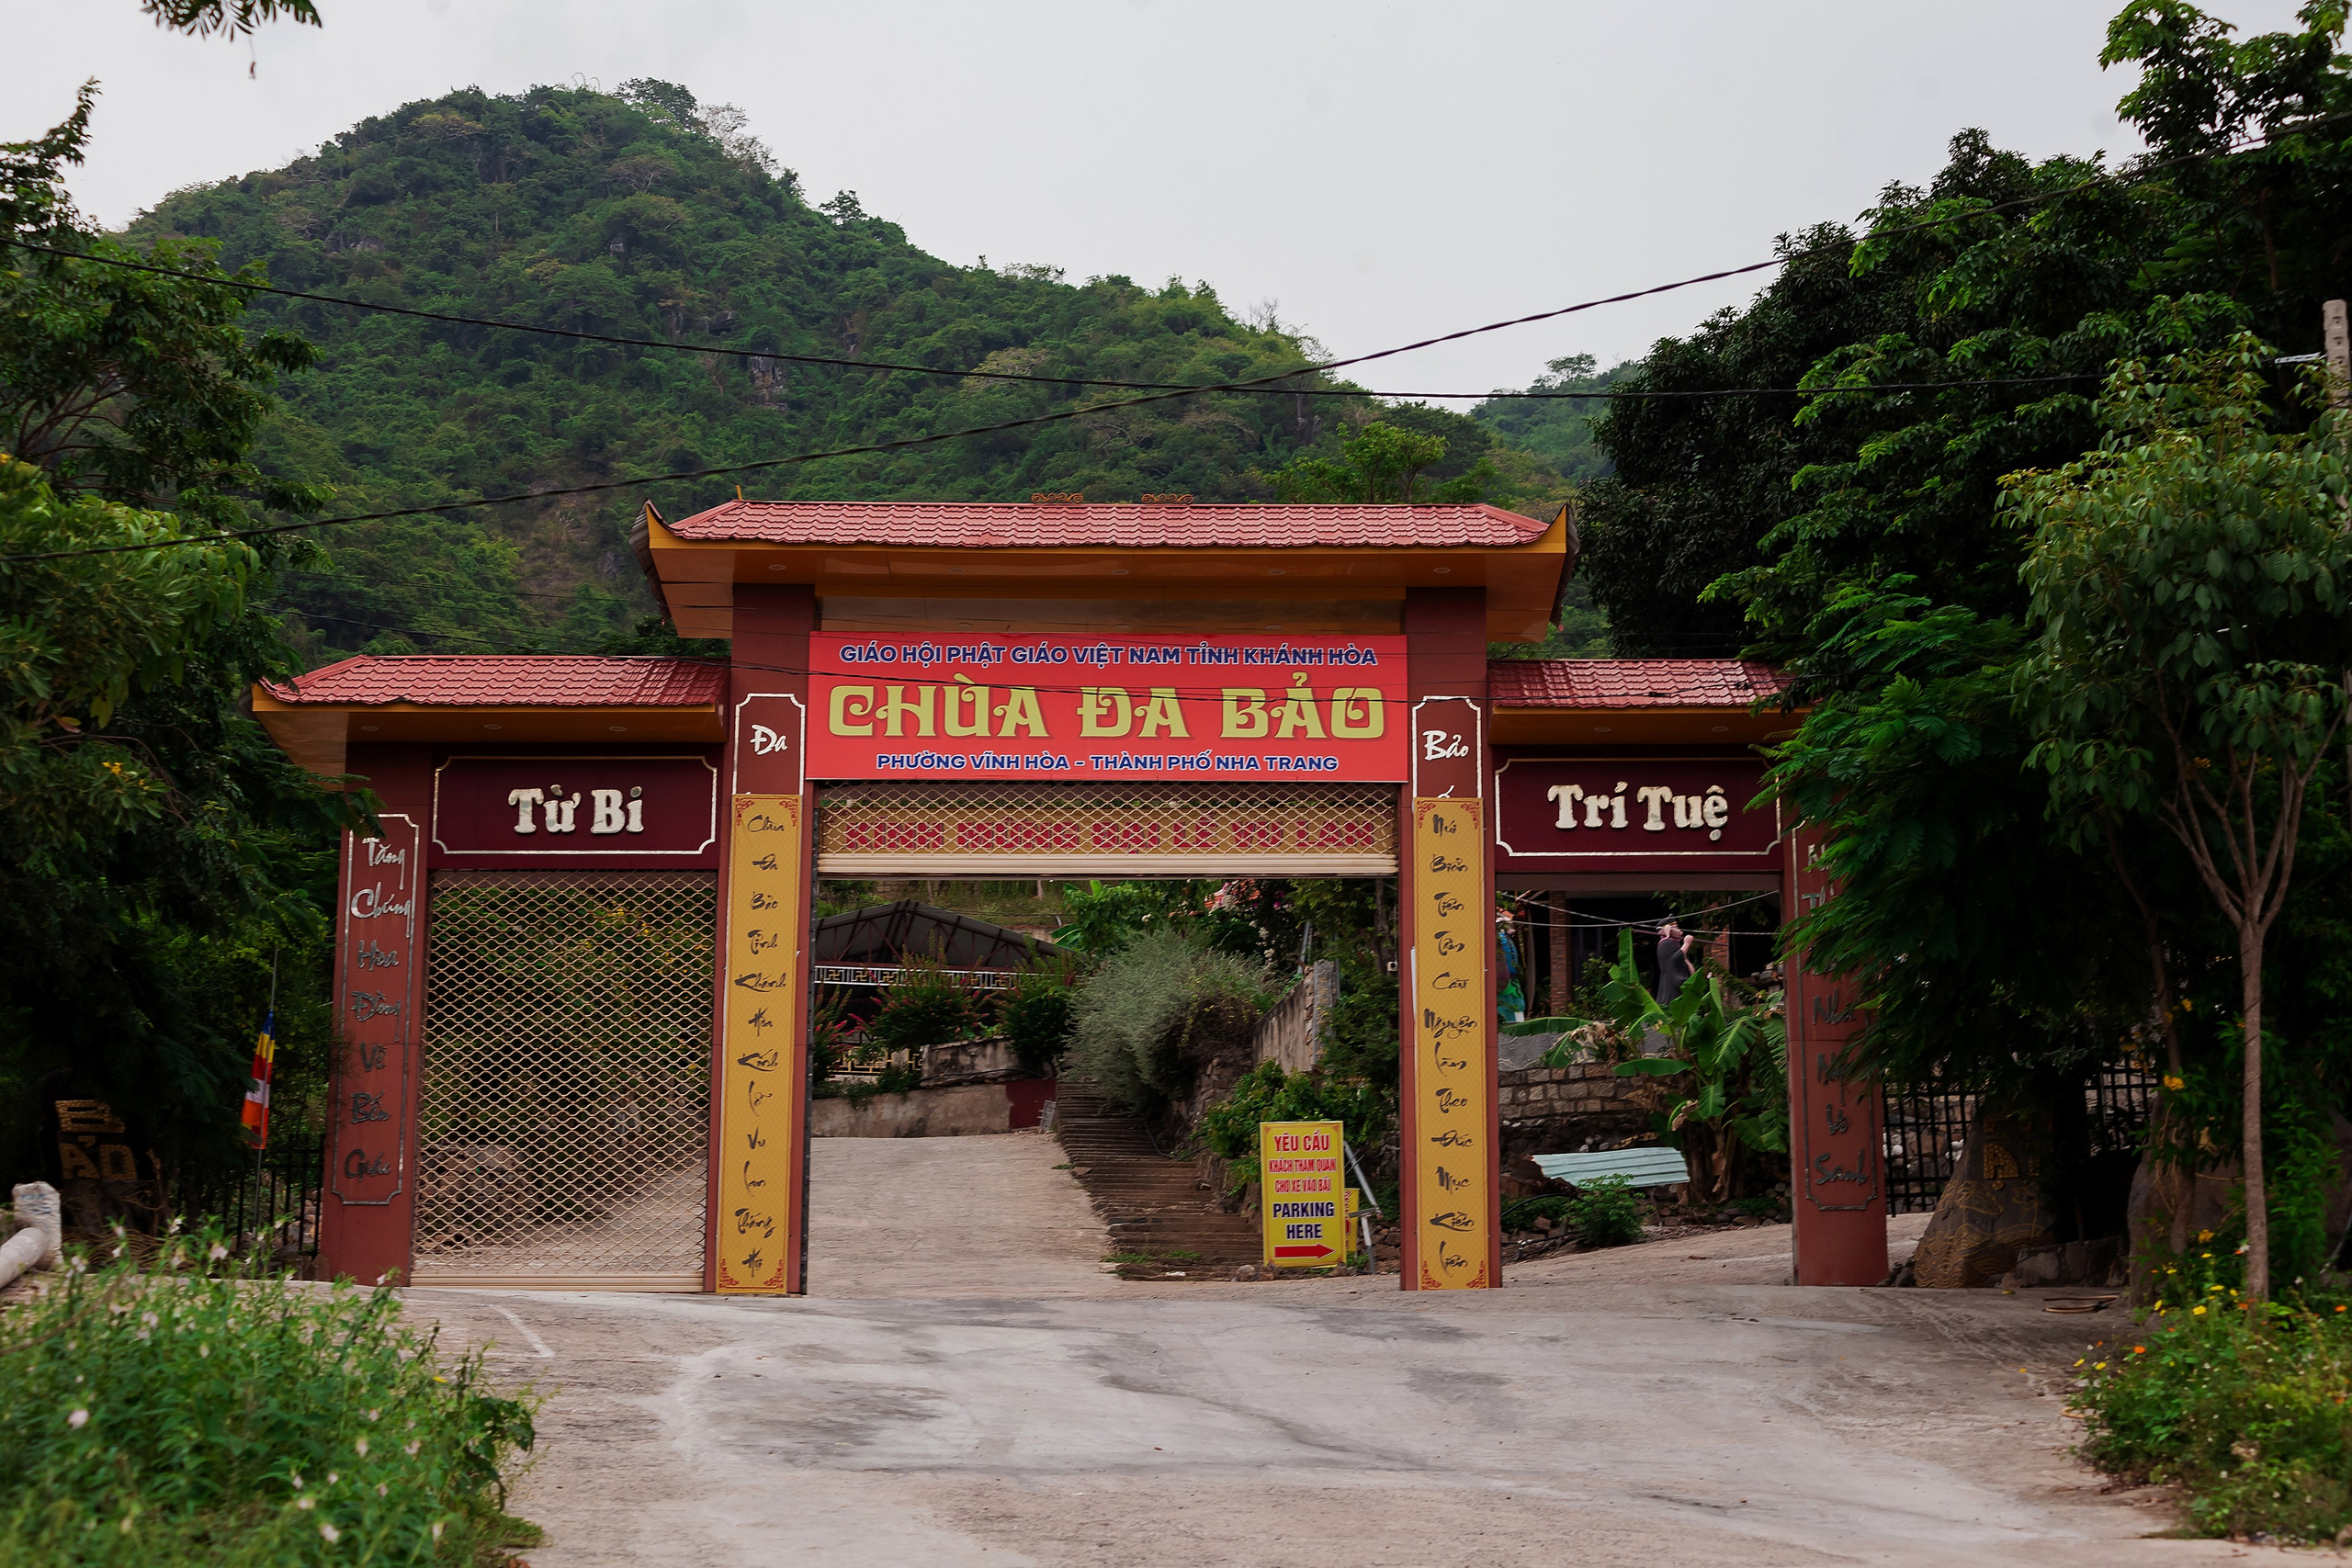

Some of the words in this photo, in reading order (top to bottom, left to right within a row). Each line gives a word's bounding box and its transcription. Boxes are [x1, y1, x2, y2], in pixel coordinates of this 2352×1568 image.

[840, 641, 897, 663] GIÁO
[902, 641, 942, 668] HỘI
[946, 641, 1006, 668] PHẬT
[1011, 641, 1068, 664] GIÁO
[1072, 642, 1124, 669] VIỆT
[1128, 647, 1182, 664] NAM
[1186, 642, 1239, 665] TỈNH
[1243, 643, 1322, 665] KHÁNH
[1329, 643, 1378, 666] HÒA
[829, 672, 1051, 738] CHÙA
[1076, 686, 1192, 739] ĐA
[1219, 671, 1385, 739] BẢO
[750, 724, 788, 756] Đa
[1422, 730, 1470, 761] Bảo
[876, 751, 966, 770] PHƯỜNG
[970, 751, 1021, 770] VĨNH
[1024, 751, 1070, 771] HÒA
[1090, 751, 1163, 771] THÀNH
[1167, 750, 1212, 771] PHỐ
[1216, 755, 1261, 771] NHA
[1265, 756, 1340, 772] TRANG
[507, 784, 582, 834] Từ
[590, 785, 644, 834] Bi
[1546, 781, 1629, 829] Trí
[1637, 784, 1729, 841] Tuệ
[1273, 1132, 1299, 1152] YÊU
[1268, 1156, 1294, 1173] KHÁCH
[1295, 1158, 1315, 1172] THAM
[1317, 1157, 1337, 1173] QUAN
[1274, 1179, 1290, 1193] CHO
[1291, 1179, 1302, 1192] XE
[1272, 1201, 1335, 1218] PARKING
[1286, 1224, 1323, 1239] HERE
